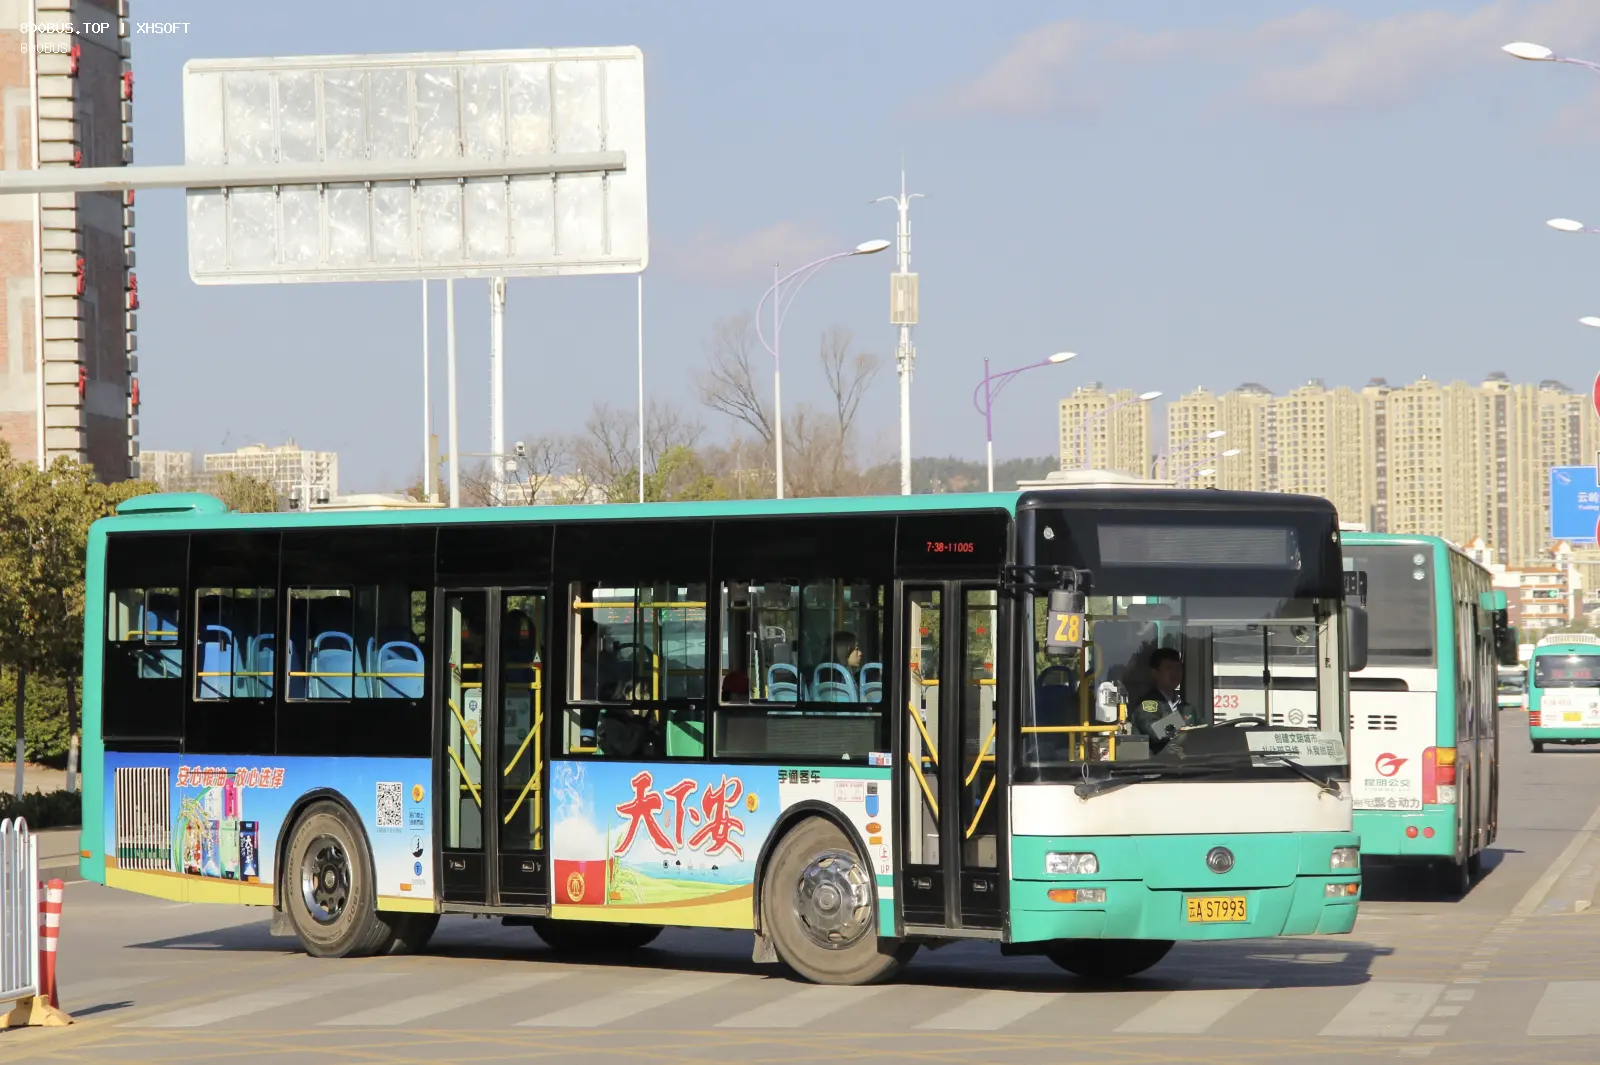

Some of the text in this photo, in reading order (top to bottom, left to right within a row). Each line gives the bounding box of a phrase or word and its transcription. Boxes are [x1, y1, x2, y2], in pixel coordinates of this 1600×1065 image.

[1054, 614, 1080, 643] Z8
[1274, 733, 1318, 744] 创建文明城市
[233, 766, 285, 788] 放心选择
[777, 769, 821, 784] 宇通客车
[1364, 778, 1411, 787] 昆明公交
[880, 864, 890, 874] UP
